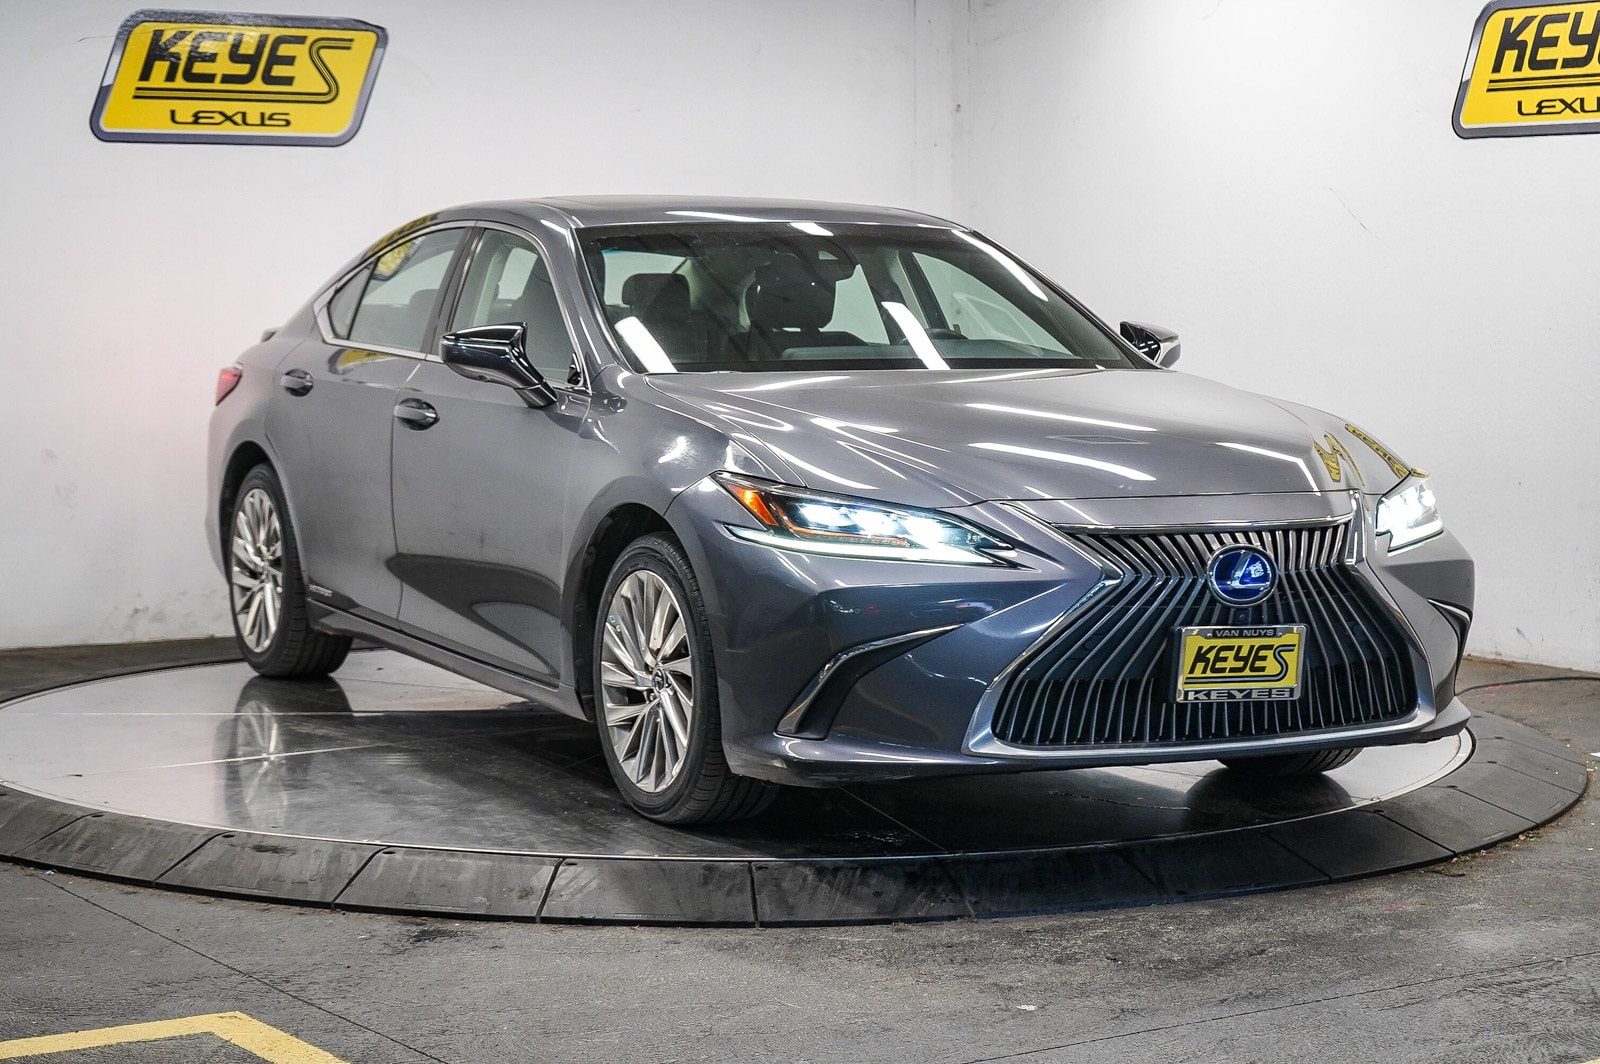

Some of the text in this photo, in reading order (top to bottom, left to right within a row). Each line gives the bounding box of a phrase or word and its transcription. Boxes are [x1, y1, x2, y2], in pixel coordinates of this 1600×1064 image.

[1491, 10, 1600, 74] KEY
[137, 29, 354, 103] KEYES
[170, 109, 291, 127] LEXUS
[1187, 644, 1296, 683] KEYES
[1187, 688, 1290, 700] KEYES
